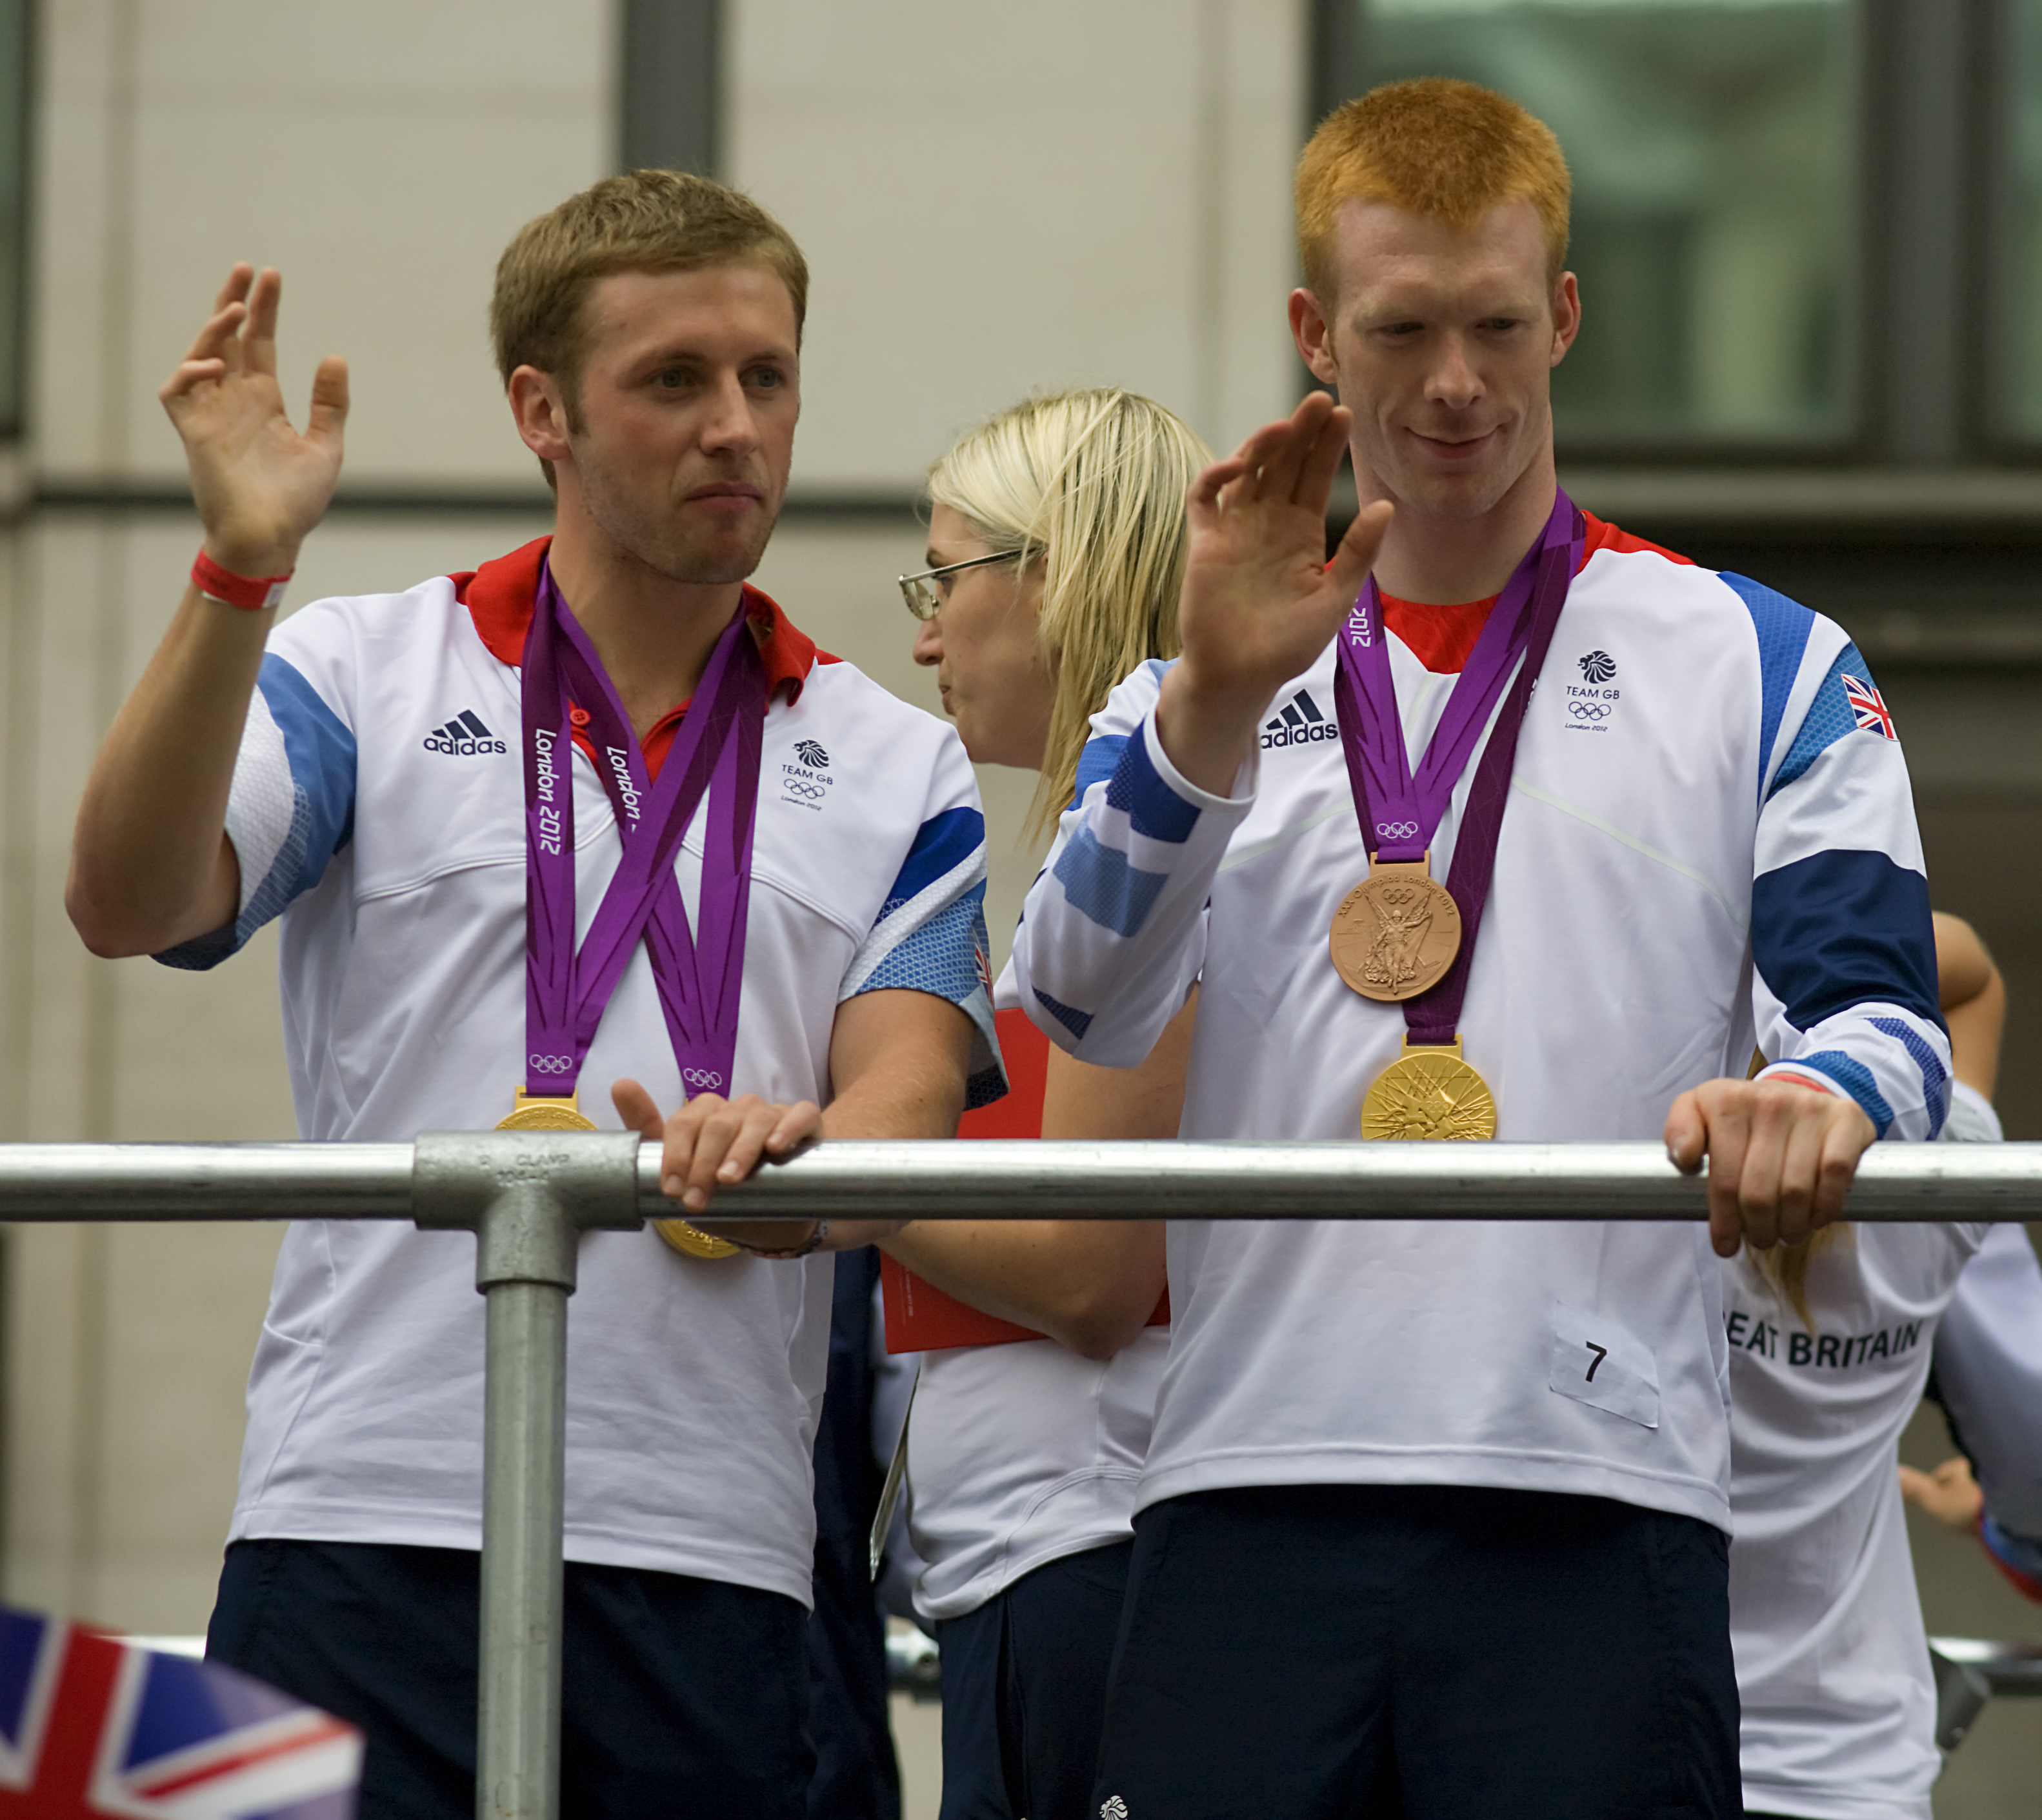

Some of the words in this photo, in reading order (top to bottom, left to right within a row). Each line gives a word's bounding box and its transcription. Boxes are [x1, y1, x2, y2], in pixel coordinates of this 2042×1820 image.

[1348, 608, 1371, 647] 2012
[1567, 686, 1599, 698] TEAM
[1603, 689, 1619, 699] GB
[423, 737, 507, 755] adidas
[1261, 723, 1339, 749] adidas
[536, 728, 560, 802] London
[606, 746, 642, 820] London
[782, 765, 813, 779] TEAM
[817, 774, 833, 785] GB
[781, 795, 805, 806] London
[806, 803, 822, 811] 2012
[539, 805, 561, 855] 2012
[1337, 900, 1355, 917] XXX
[1354, 874, 1400, 898] Olympiad
[1403, 875, 1437, 894] London
[1437, 892, 1456, 917] 2012
[1723, 1310, 1778, 1359] EAT
[1788, 1318, 1923, 1368] BRITAIN
[1586, 1341, 1607, 1383] 7
